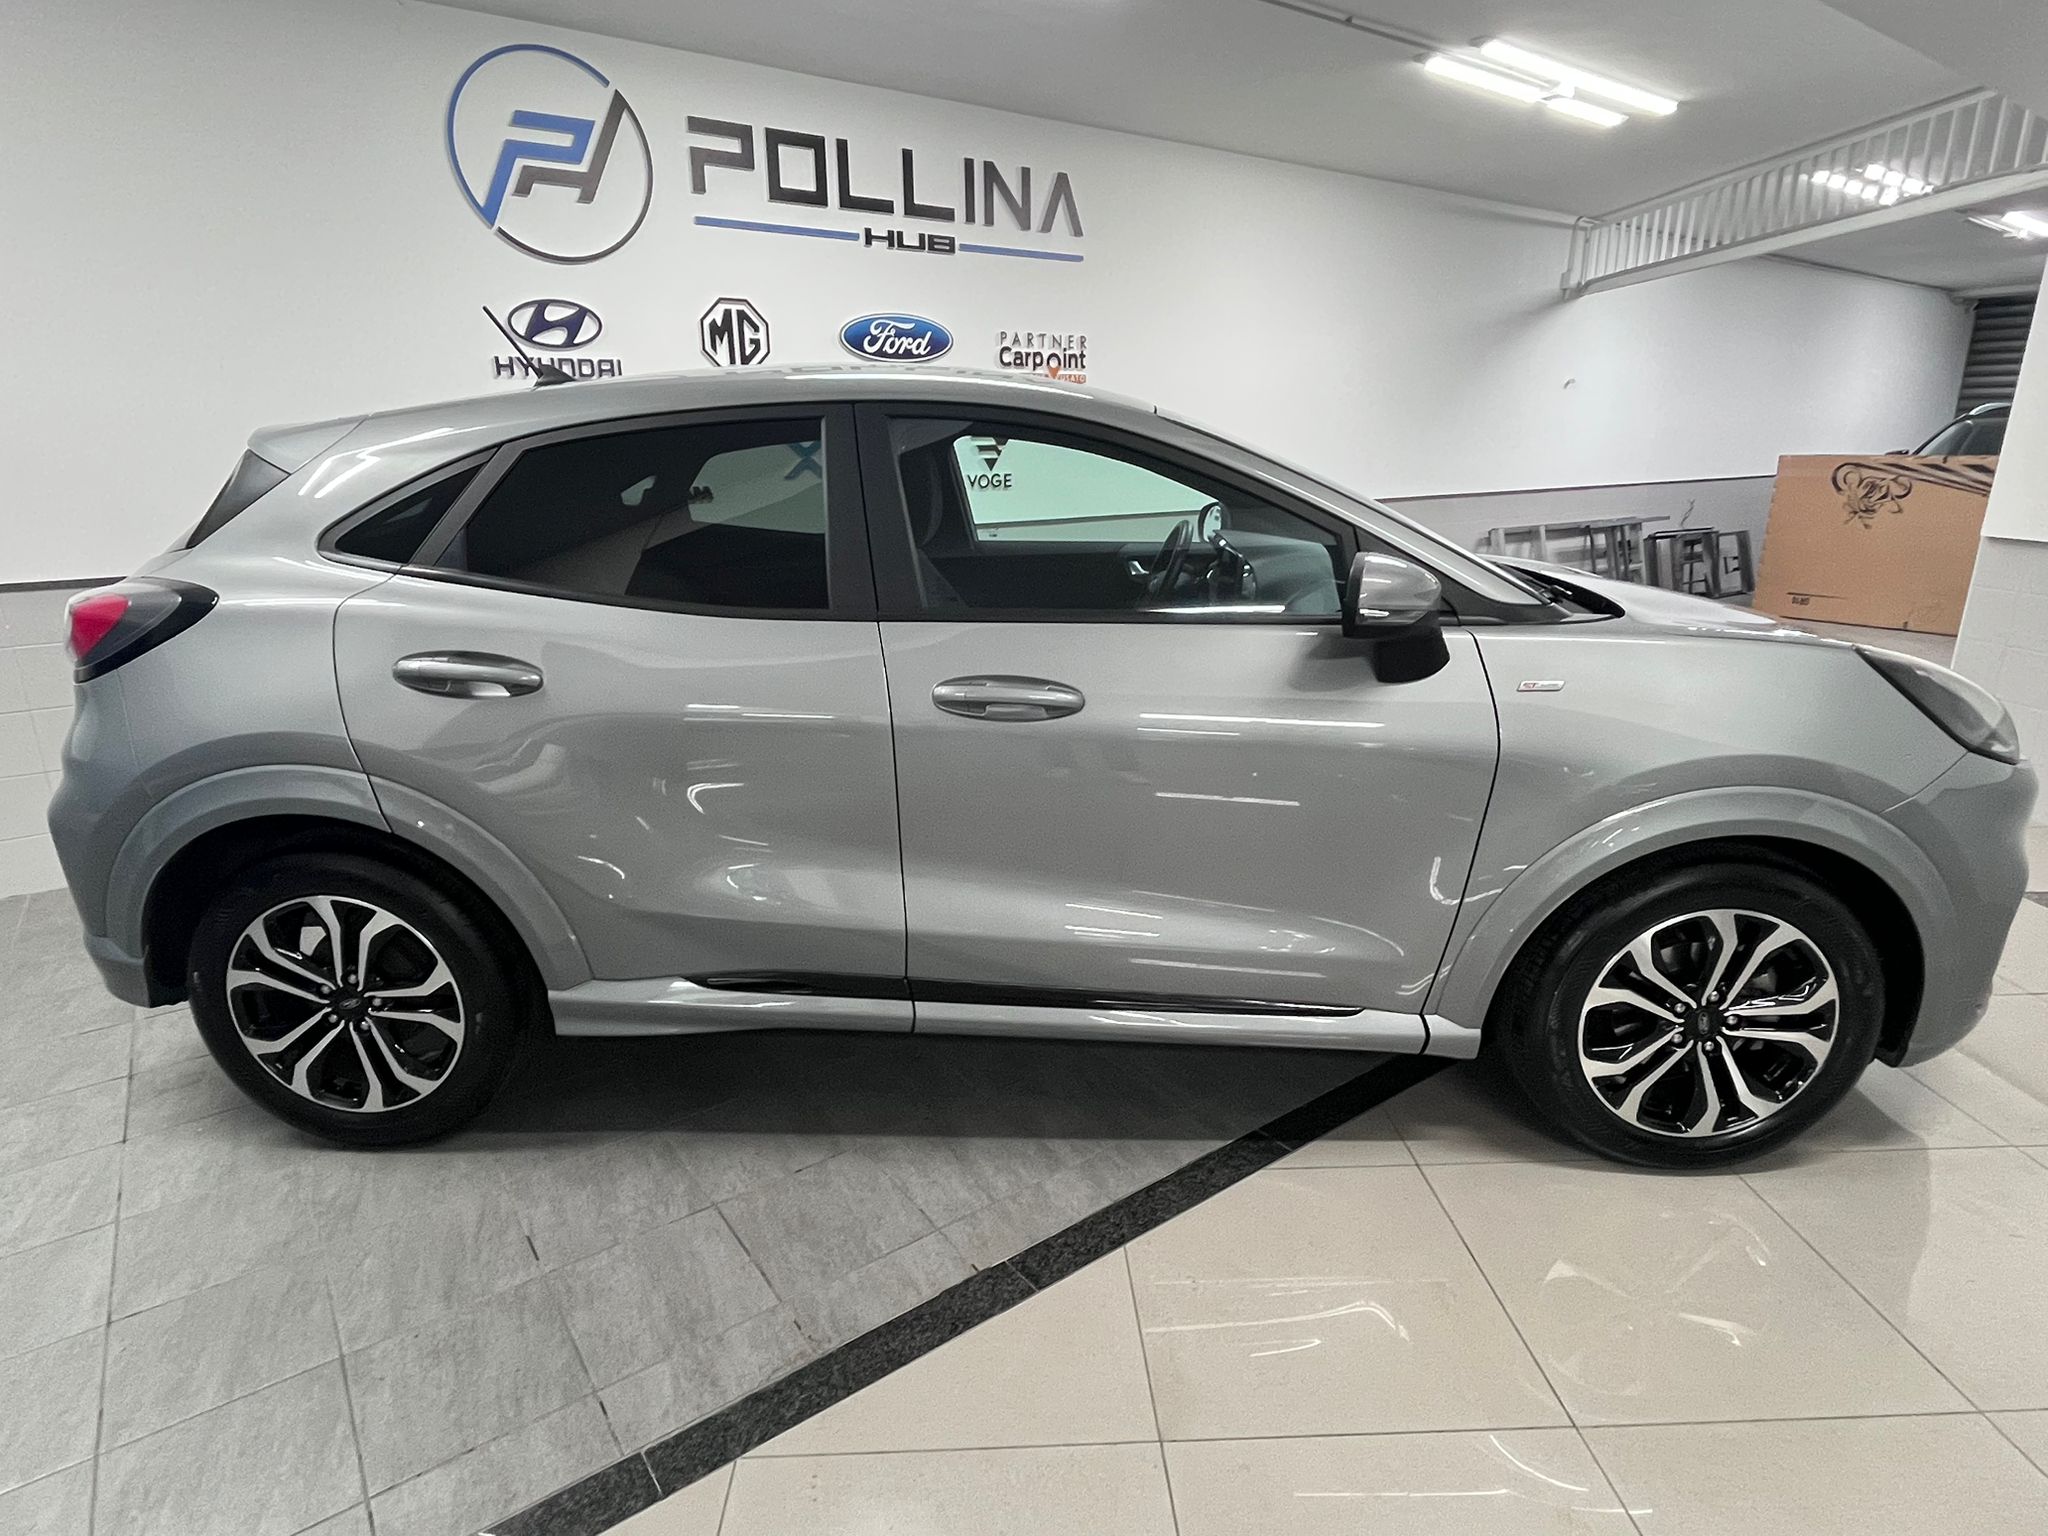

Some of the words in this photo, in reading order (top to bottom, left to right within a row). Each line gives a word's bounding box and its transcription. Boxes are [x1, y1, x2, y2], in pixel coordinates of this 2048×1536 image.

[687, 115, 1084, 238] POLLINA
[864, 227, 956, 255] HUB
[708, 308, 761, 366] MG
[863, 319, 932, 355] Ford
[1000, 331, 1087, 350] PARTNER
[999, 345, 1087, 373] Carpoint
[967, 473, 1012, 489] VOGE
